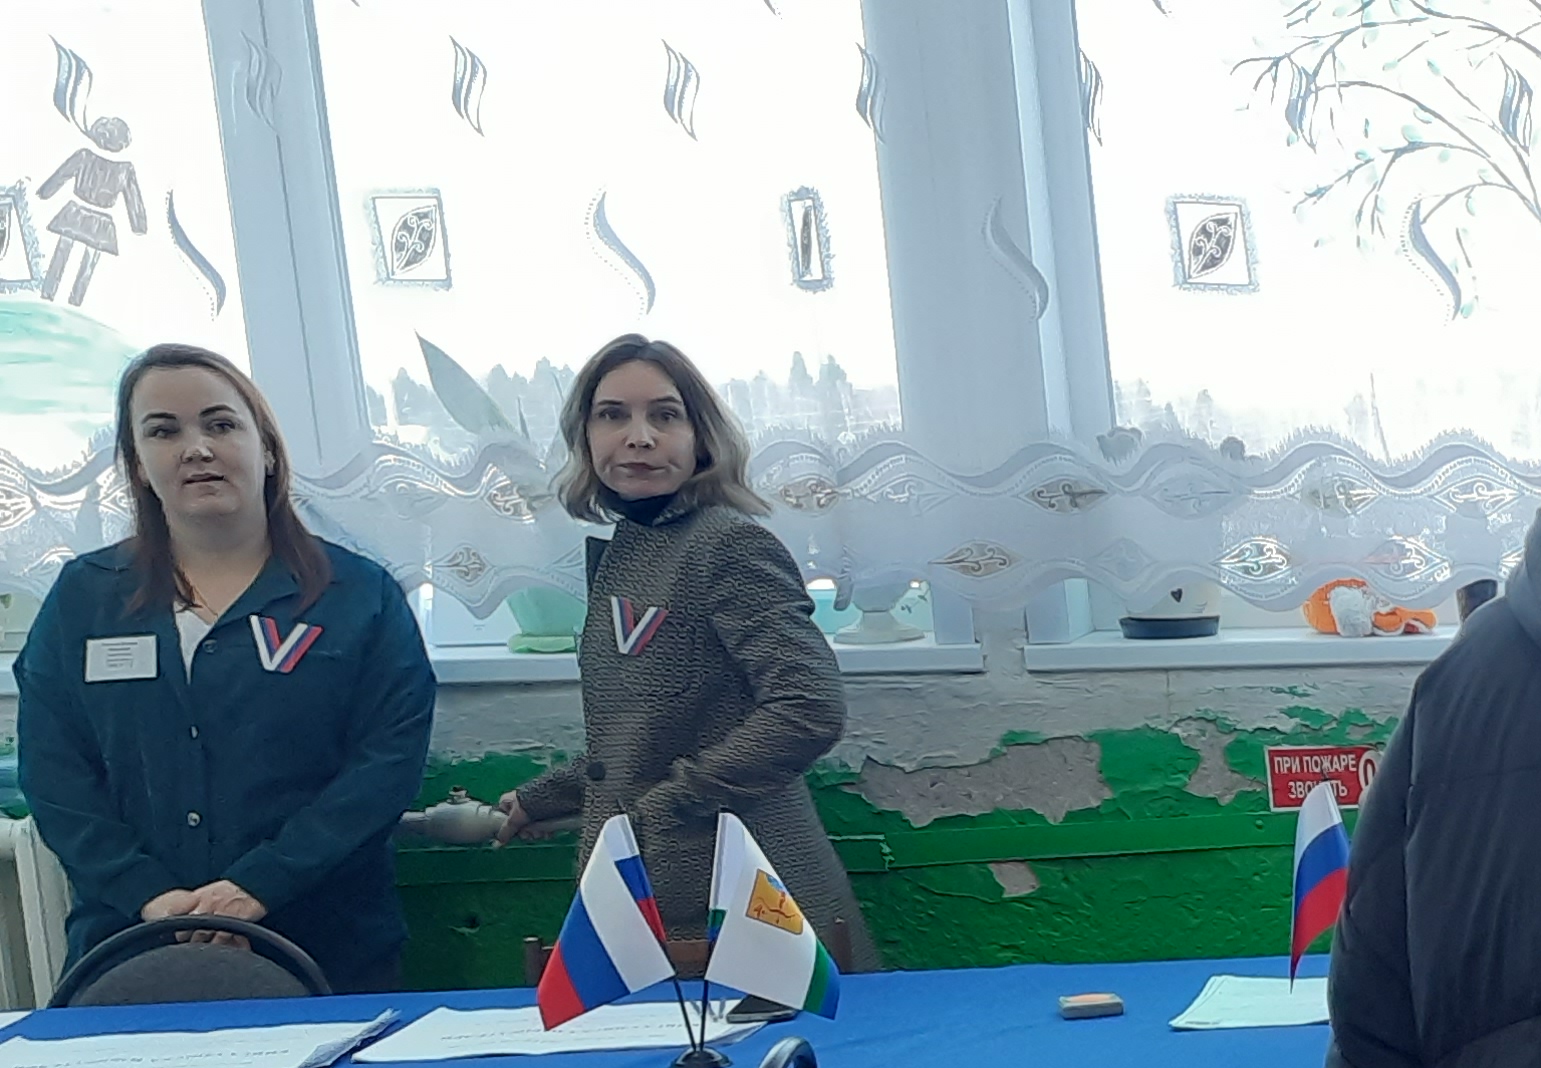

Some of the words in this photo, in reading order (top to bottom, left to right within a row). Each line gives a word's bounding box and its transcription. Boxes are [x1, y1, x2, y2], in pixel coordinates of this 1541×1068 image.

[1274, 756, 1300, 774] ПРИ
[1303, 754, 1357, 773] ПОЖАРЕ
[1287, 780, 1348, 799] ЗВОТЬ
